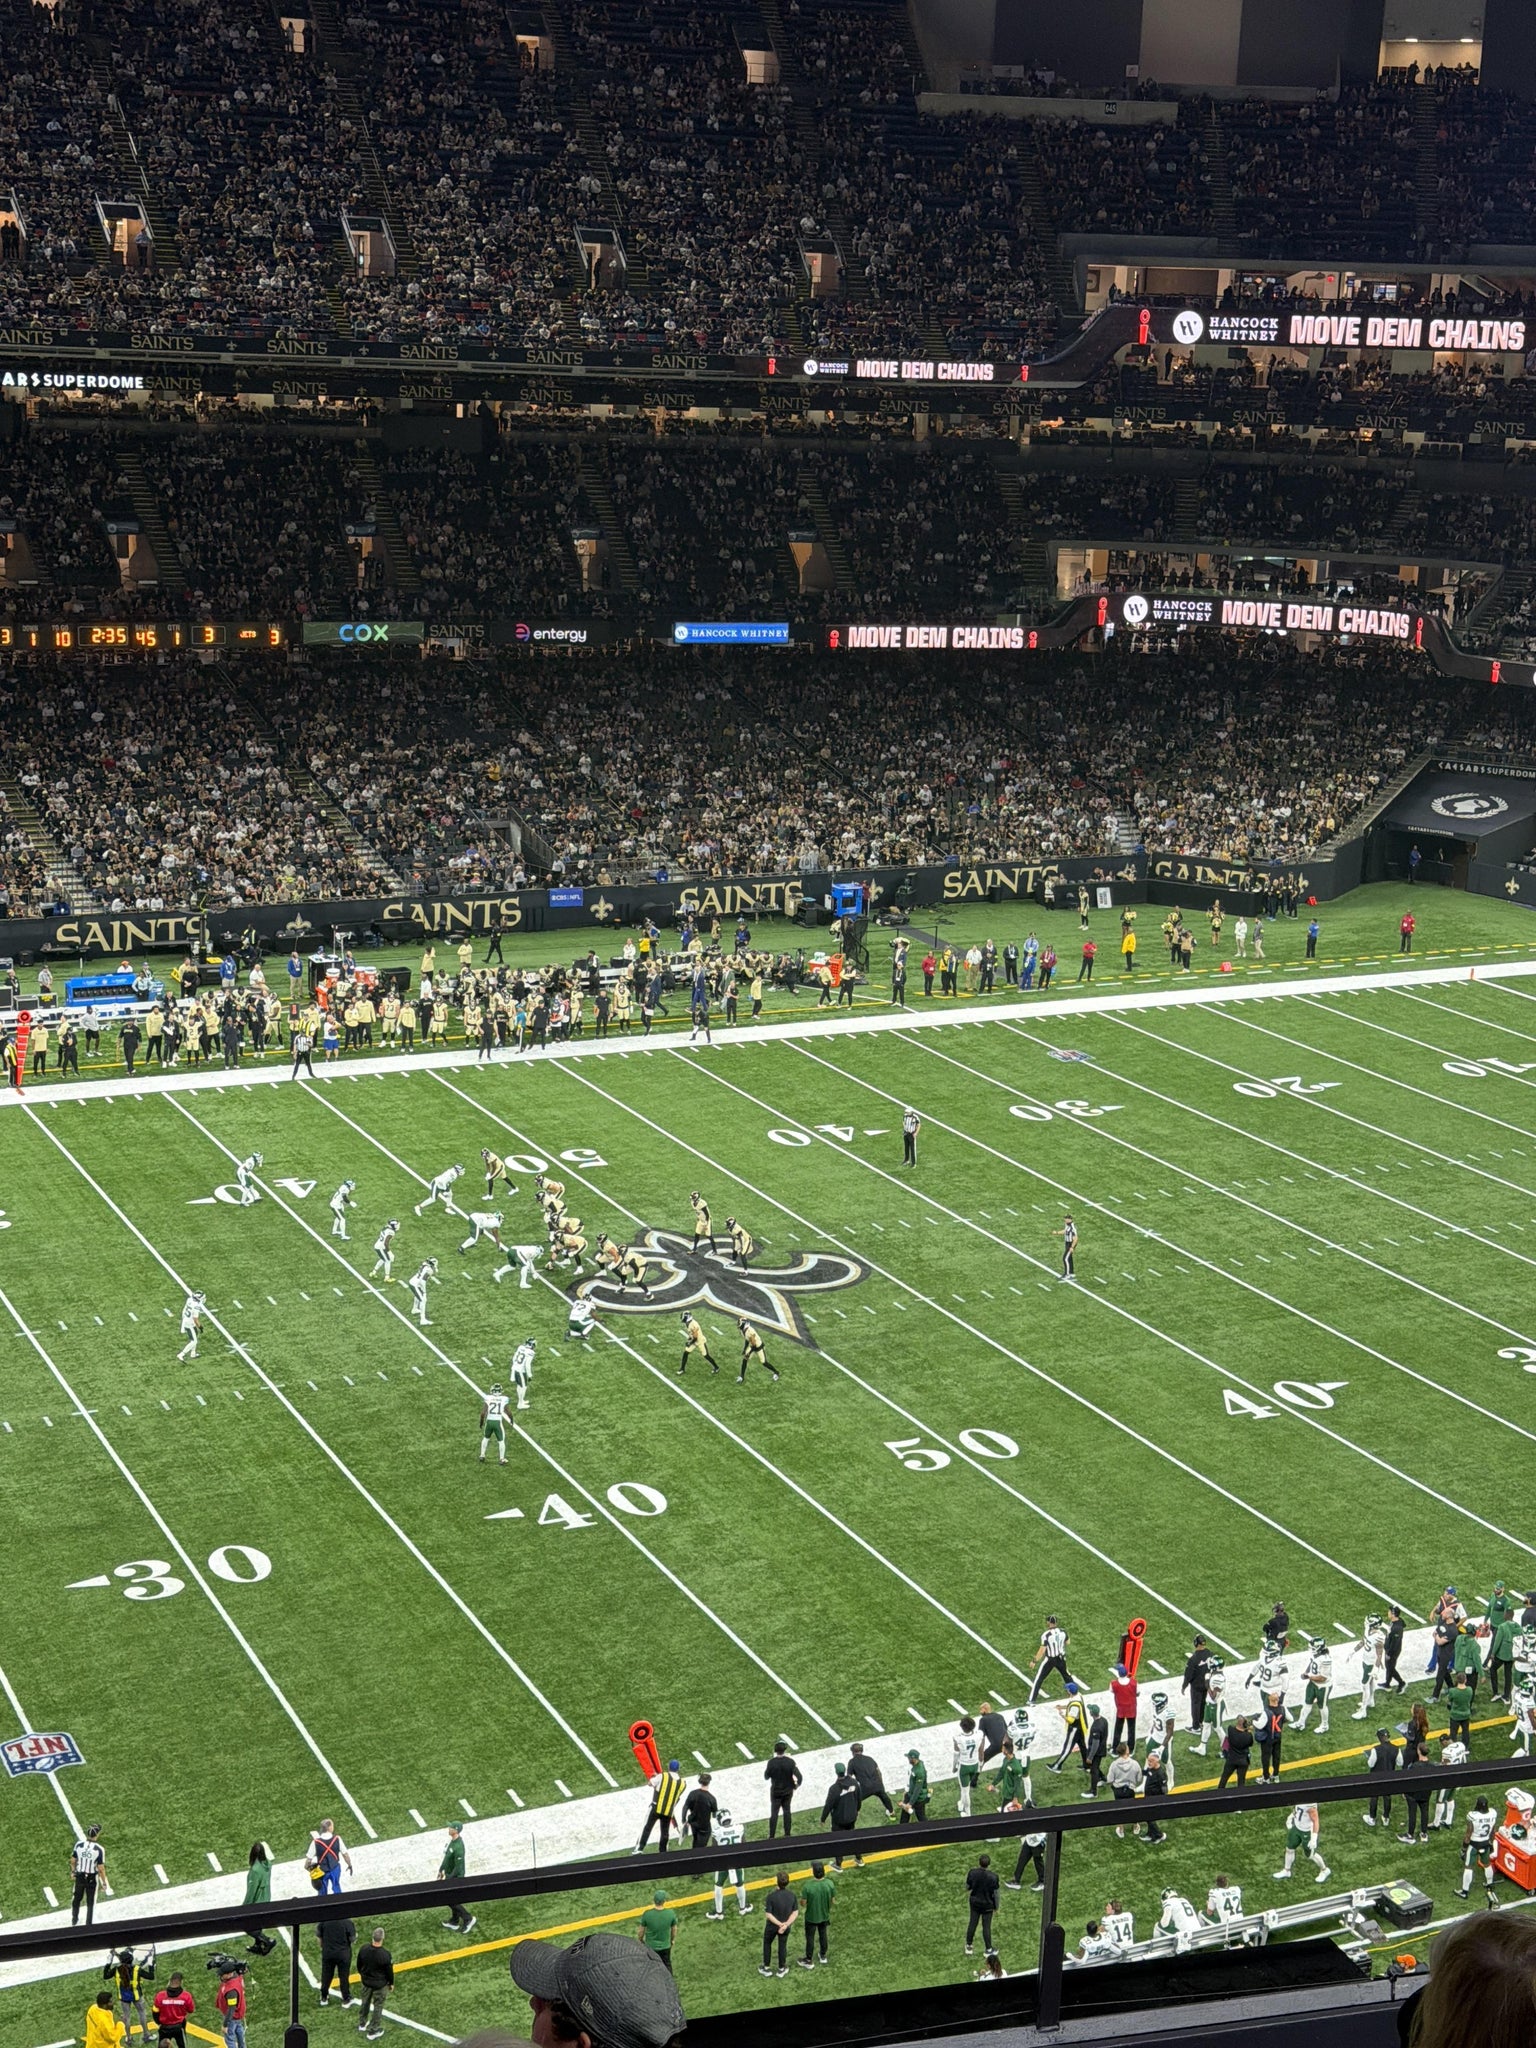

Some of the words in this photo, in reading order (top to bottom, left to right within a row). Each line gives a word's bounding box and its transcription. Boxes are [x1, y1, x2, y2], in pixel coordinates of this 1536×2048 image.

[1209, 316, 1279, 329] HANCOCK
[0, 329, 53, 345] AINTS
[1209, 329, 1278, 342] WHITNEY
[1290, 315, 1360, 346] MOVE
[1366, 317, 1423, 347] DEM
[1428, 319, 1525, 350] CHAINS
[131, 335, 194, 350] SAINTS
[267, 340, 328, 355] SAINTS
[400, 344, 459, 360] SAINTS
[526, 350, 583, 365] SAINTS
[652, 354, 707, 369] SAINTS
[856, 360, 898, 378] MOVE
[901, 361, 934, 380] DEM
[938, 362, 994, 381] CHAINS
[43, 373, 144, 389] SUPERDOME
[145, 376, 201, 391] SAINTS
[272, 381, 328, 395] SAINTS
[399, 385, 453, 399] SAINTS
[520, 388, 573, 402] SAINTS
[643, 392, 695, 406] SAINTS
[760, 396, 811, 410] SAINTS
[879, 400, 930, 412] SAINTS
[993, 402, 1043, 416] SAINTS
[1114, 406, 1166, 420] SAINTS
[1232, 410, 1286, 424] SAINTS
[1355, 414, 1408, 428] SAINTS
[1474, 420, 1525, 435] SAINTS
[1153, 600, 1212, 612] HANCOCK
[1153, 611, 1211, 622] WHITNEY
[1222, 601, 1281, 628] MOVE
[1287, 604, 1333, 631] DEM
[1338, 608, 1410, 639] CHAINS
[1, 628, 10, 644] 3
[91, 628, 126, 643] 2:35
[135, 631, 156, 646] 45
[174, 632, 180, 645] 1
[205, 627, 214, 643] 3
[239, 630, 256, 638] JETS
[270, 630, 280, 645] 3
[339, 624, 389, 642] COX
[430, 624, 485, 638] SAINTS
[533, 628, 587, 643] entergy
[692, 629, 737, 638] HANCOCK
[741, 630, 788, 638] WHITNEY
[848, 626, 901, 648] MOVE
[906, 626, 947, 648] DEM
[952, 627, 1023, 649] CHAINS
[31, 632, 36, 646] 1
[55, 631, 71, 647] 10
[943, 864, 1059, 899] SAINTS
[680, 880, 803, 914] SAINTS
[383, 897, 522, 931] SAINTS
[55, 917, 210, 952] SAINTS
[1232, 1076, 1325, 1099] 20
[1009, 1099, 1105, 1121] 30
[767, 1124, 854, 1147] 40
[504, 1149, 609, 1174] 50
[1222, 1380, 1334, 1419] 40
[489, 1402, 502, 1415] 21
[883, 1428, 1020, 1471] 50
[537, 1482, 668, 1530] 40
[113, 1545, 272, 1600] 30
[1271, 1714, 1283, 1732] K
[7, 1736, 69, 1759] NFL
[967, 1744, 976, 1759] 7
[1480, 1824, 1491, 1837] 3
[1181, 1902, 1193, 1917] 6
[1223, 1896, 1243, 1916] 42
[1114, 1923, 1131, 1943] 14
